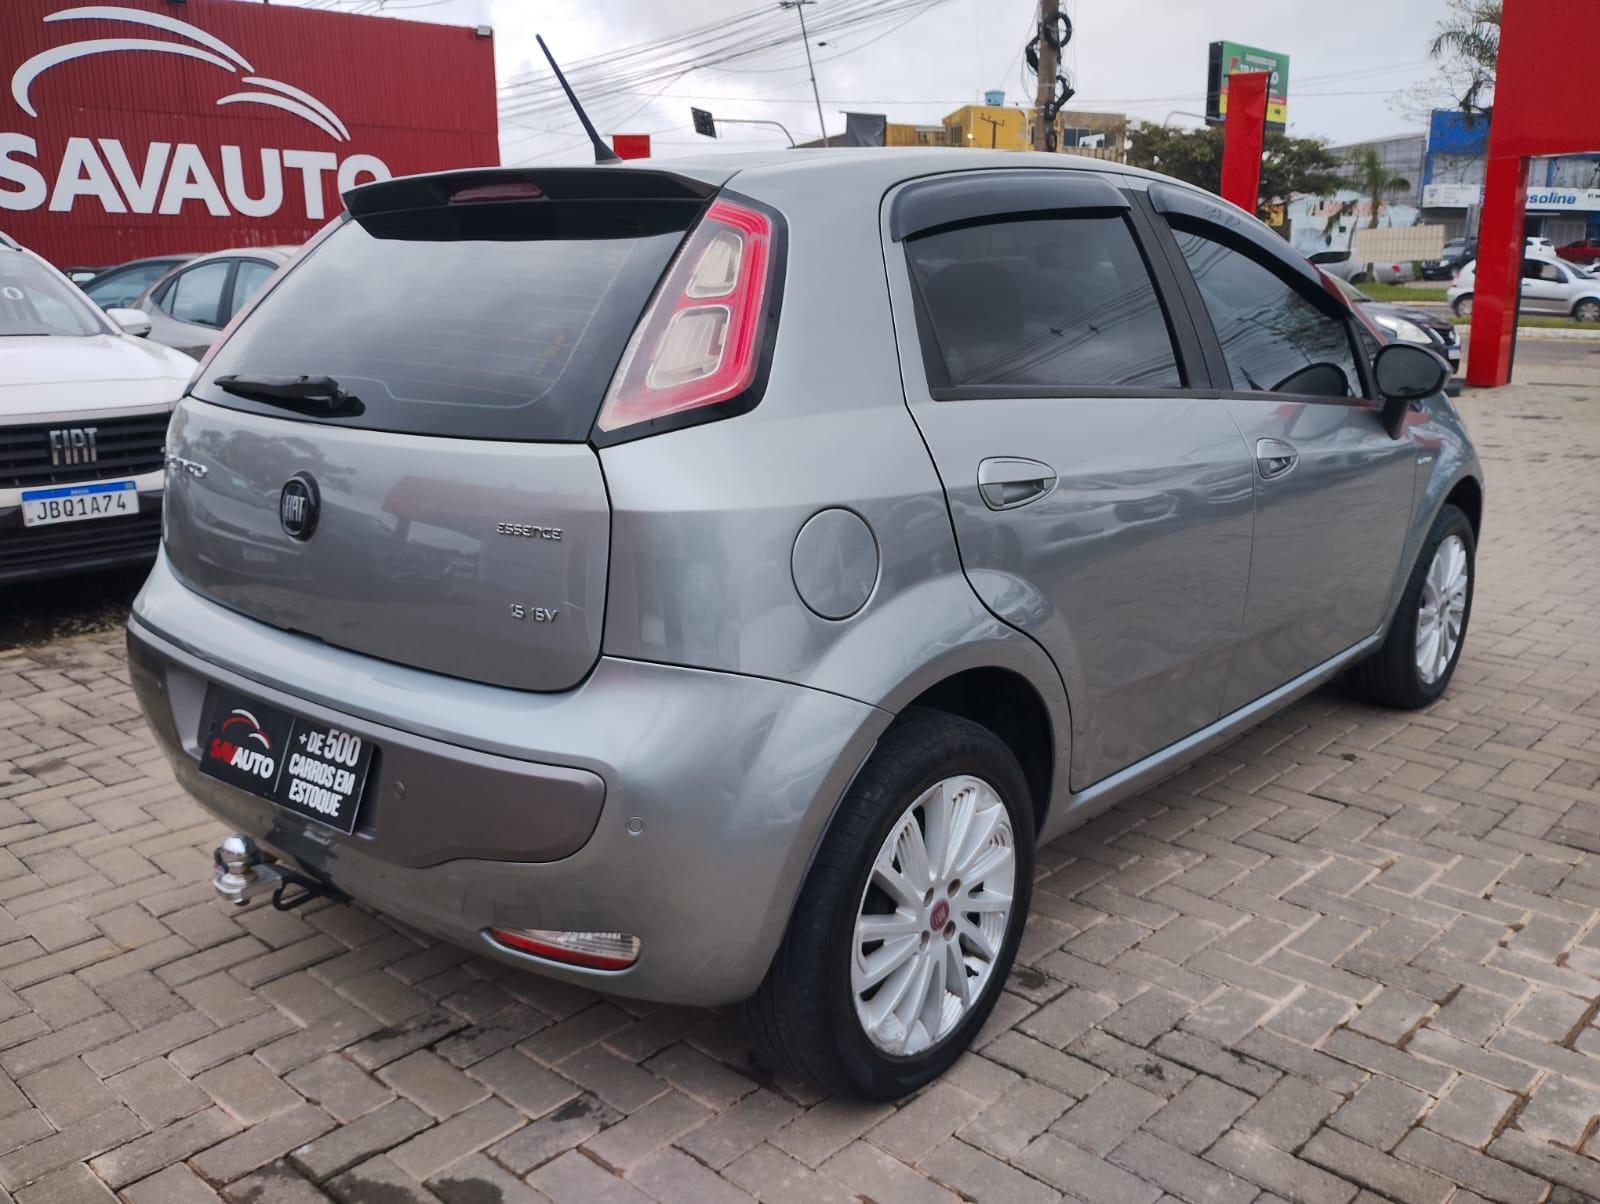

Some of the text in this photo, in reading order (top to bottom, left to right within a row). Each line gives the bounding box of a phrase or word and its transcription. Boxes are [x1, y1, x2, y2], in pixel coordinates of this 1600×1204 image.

[49, 427, 98, 466] FIAT
[37, 493, 127, 520] JBQ1A74
[285, 494, 306, 522] FIAT
[209, 737, 275, 779] SAVAUTO
[306, 730, 326, 756] DE
[323, 728, 362, 767] 500
[288, 753, 356, 796] CARROS EM
[288, 778, 343, 817] ESTOQUE
